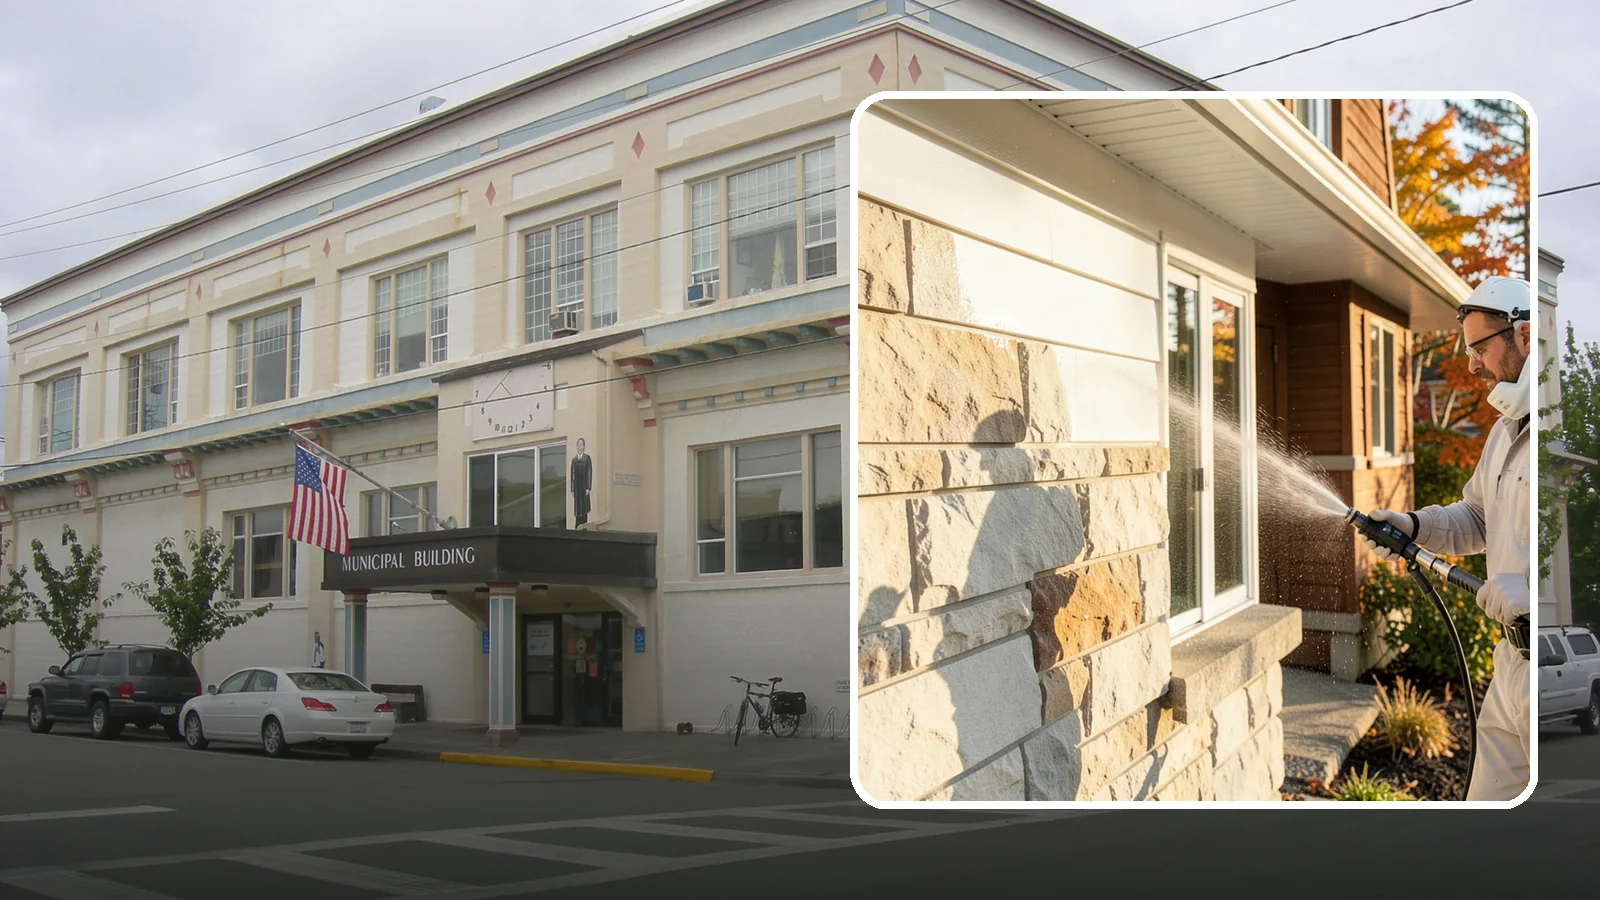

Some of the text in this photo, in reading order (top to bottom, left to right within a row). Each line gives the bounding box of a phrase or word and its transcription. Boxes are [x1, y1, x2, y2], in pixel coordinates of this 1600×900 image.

[488, 418, 492, 426] 9
[507, 425, 513, 433] 12
[342, 546, 475, 571] MUNICIPAL BUILDING
